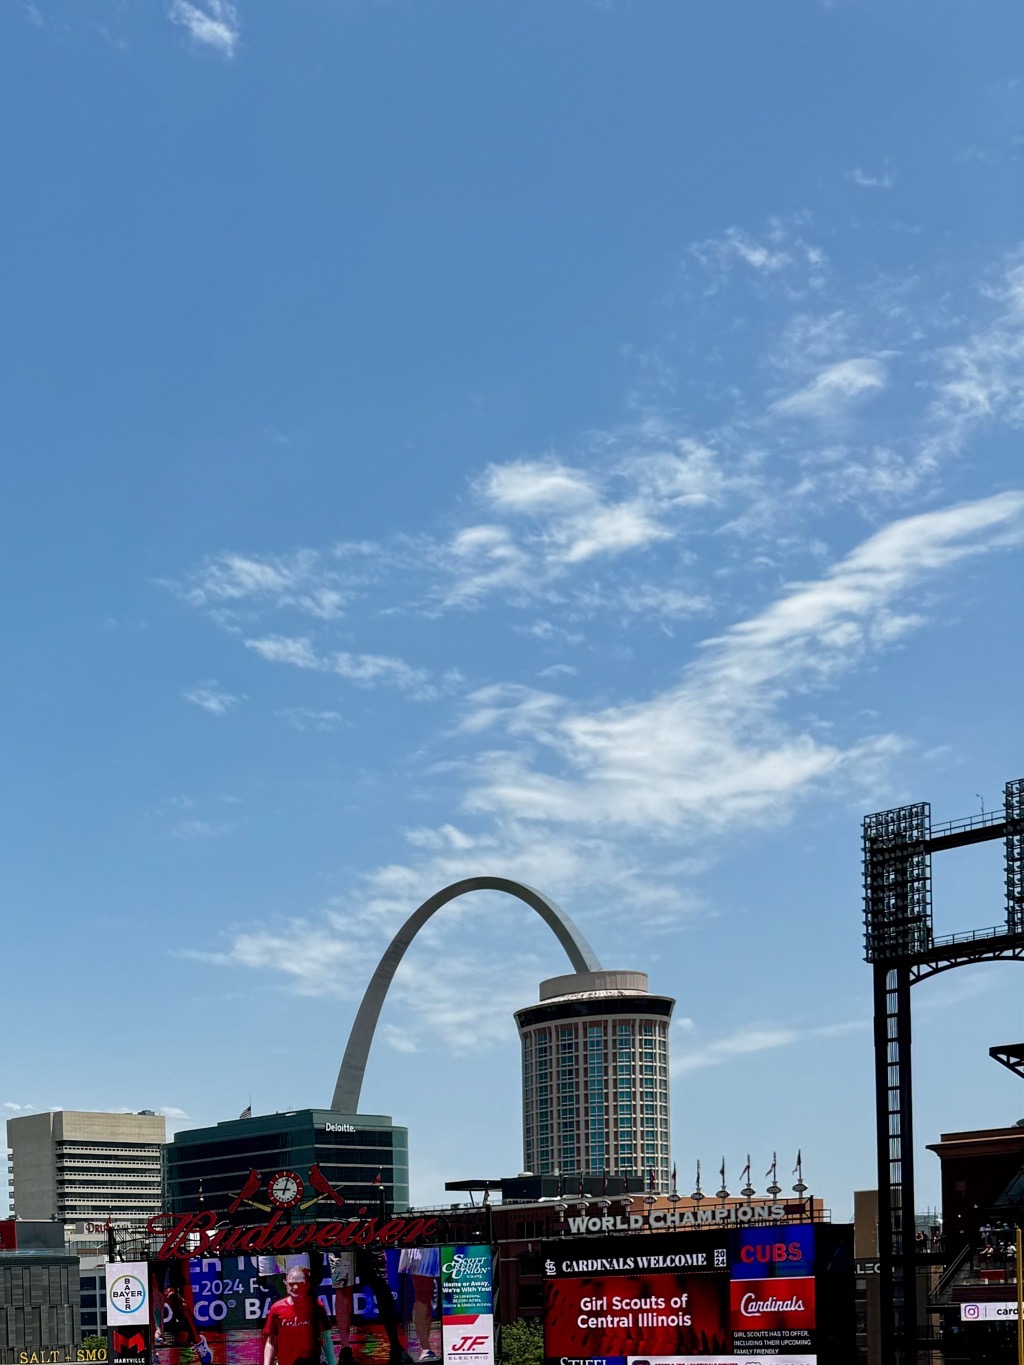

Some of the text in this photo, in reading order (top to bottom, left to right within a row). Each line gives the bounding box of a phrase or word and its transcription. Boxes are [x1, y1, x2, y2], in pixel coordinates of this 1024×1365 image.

[568, 1204, 786, 1233] WORLD CHAMPIONS
[146, 1207, 438, 1260] Budweiser
[740, 1242, 803, 1263] CUBS
[562, 1253, 707, 1273] CARDINALS WELCOME
[112, 1290, 143, 1298] BAYER
[202, 1279, 244, 1295] 2024
[580, 1293, 689, 1312] Girl Scouts of
[740, 1292, 805, 1317] Cardinals
[577, 1312, 692, 1329] Central Illinois
[20, 1351, 60, 1364] SALT
